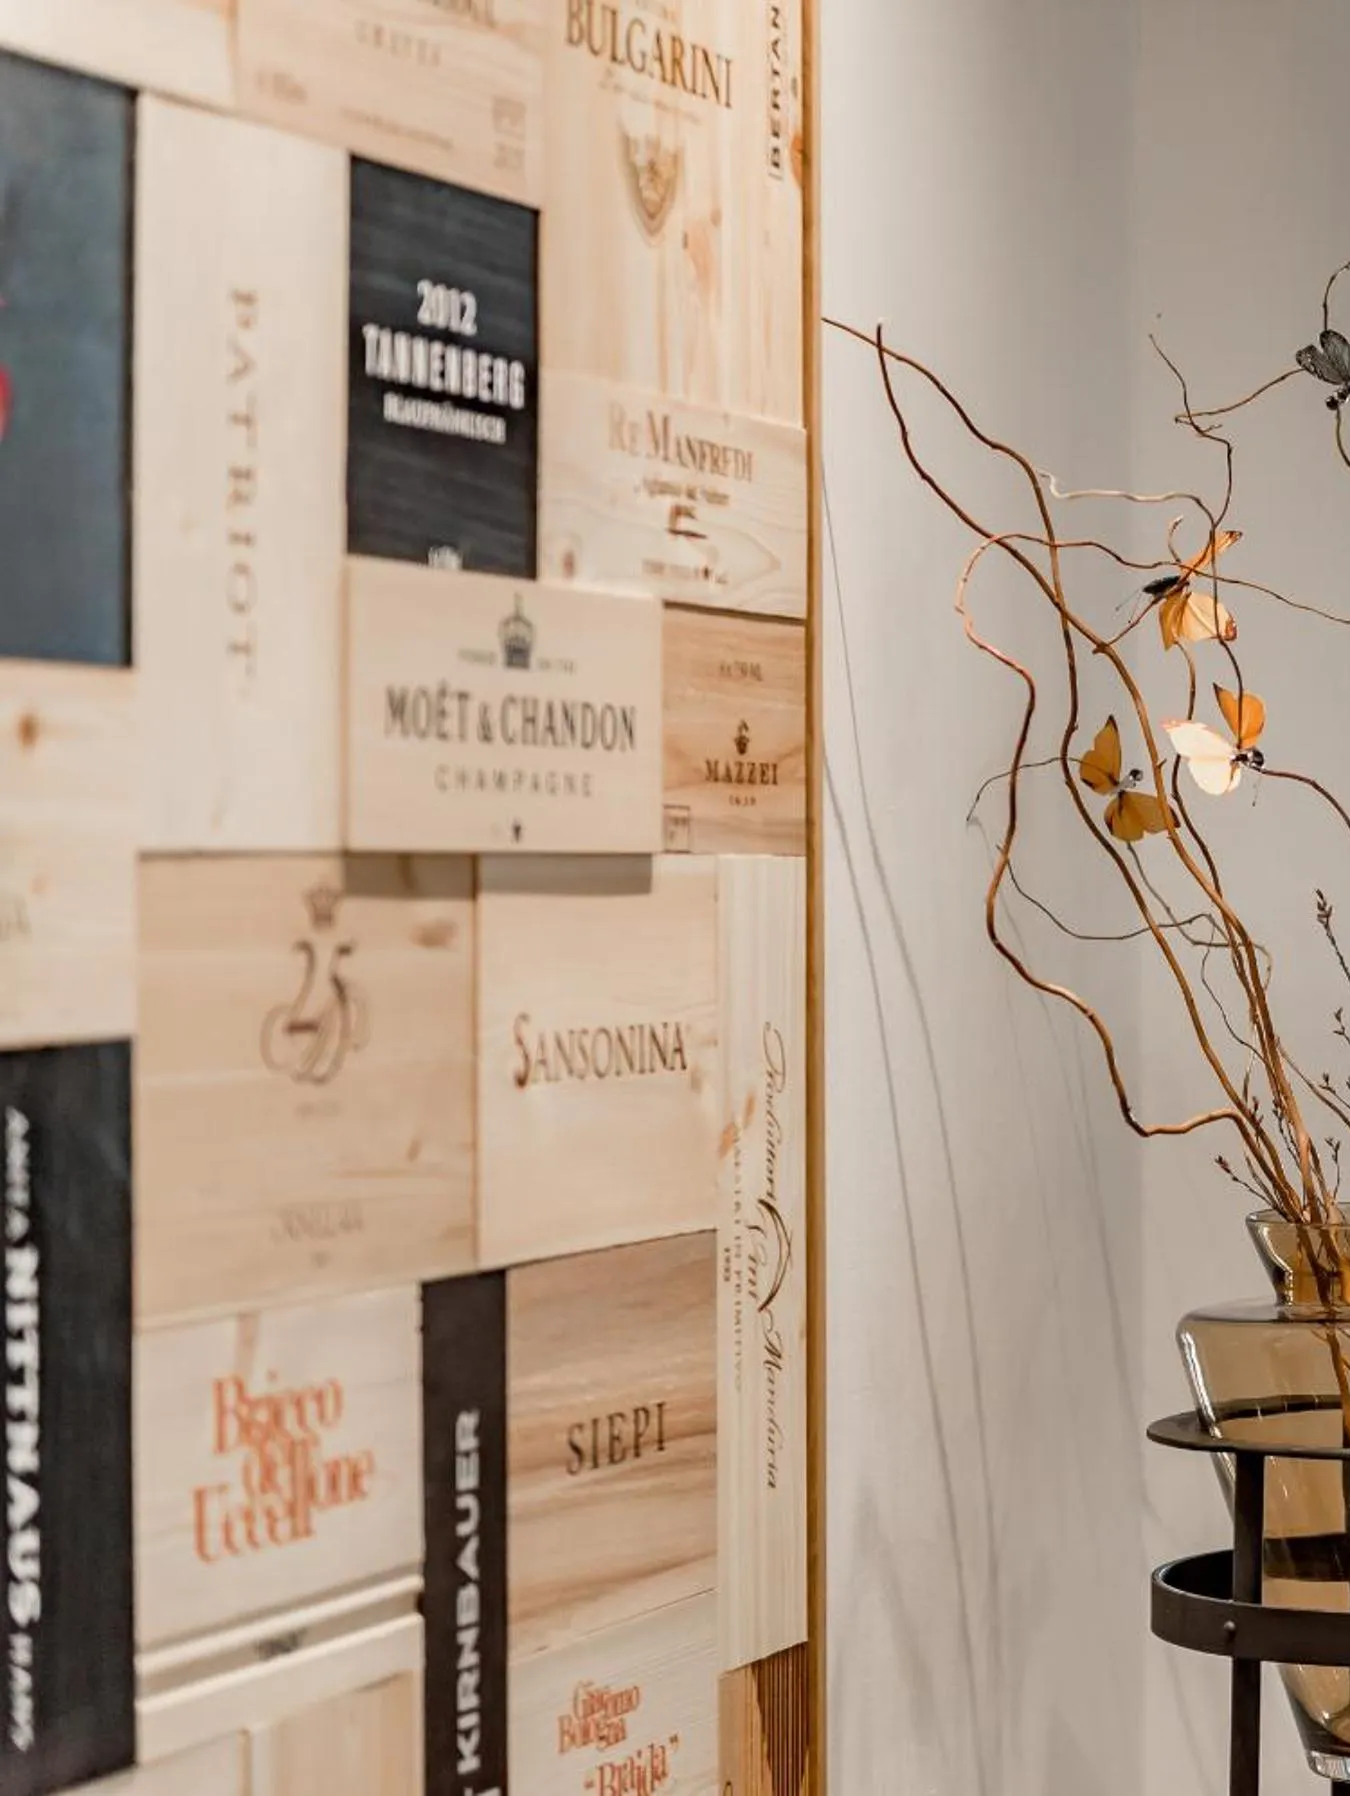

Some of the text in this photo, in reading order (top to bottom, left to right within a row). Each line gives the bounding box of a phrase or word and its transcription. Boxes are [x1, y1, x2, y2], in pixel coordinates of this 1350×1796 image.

[565, 0, 733, 109] BULGARINI
[416, 279, 478, 336] 2012
[361, 322, 525, 410] TANNENBERG
[226, 289, 258, 678] PATRIOT
[476, 701, 495, 745] &
[500, 693, 637, 752] CHANDON
[704, 757, 779, 786] MAZZEI
[433, 763, 595, 798] CHAMPAGNE
[762, 1020, 787, 1201] Produttori
[4, 1246, 41, 1628] NITTNAUS
[564, 1400, 668, 1478] SIEPI
[762, 1307, 787, 1491] Manduria
[454, 1407, 481, 1776] KIRNBAUER
